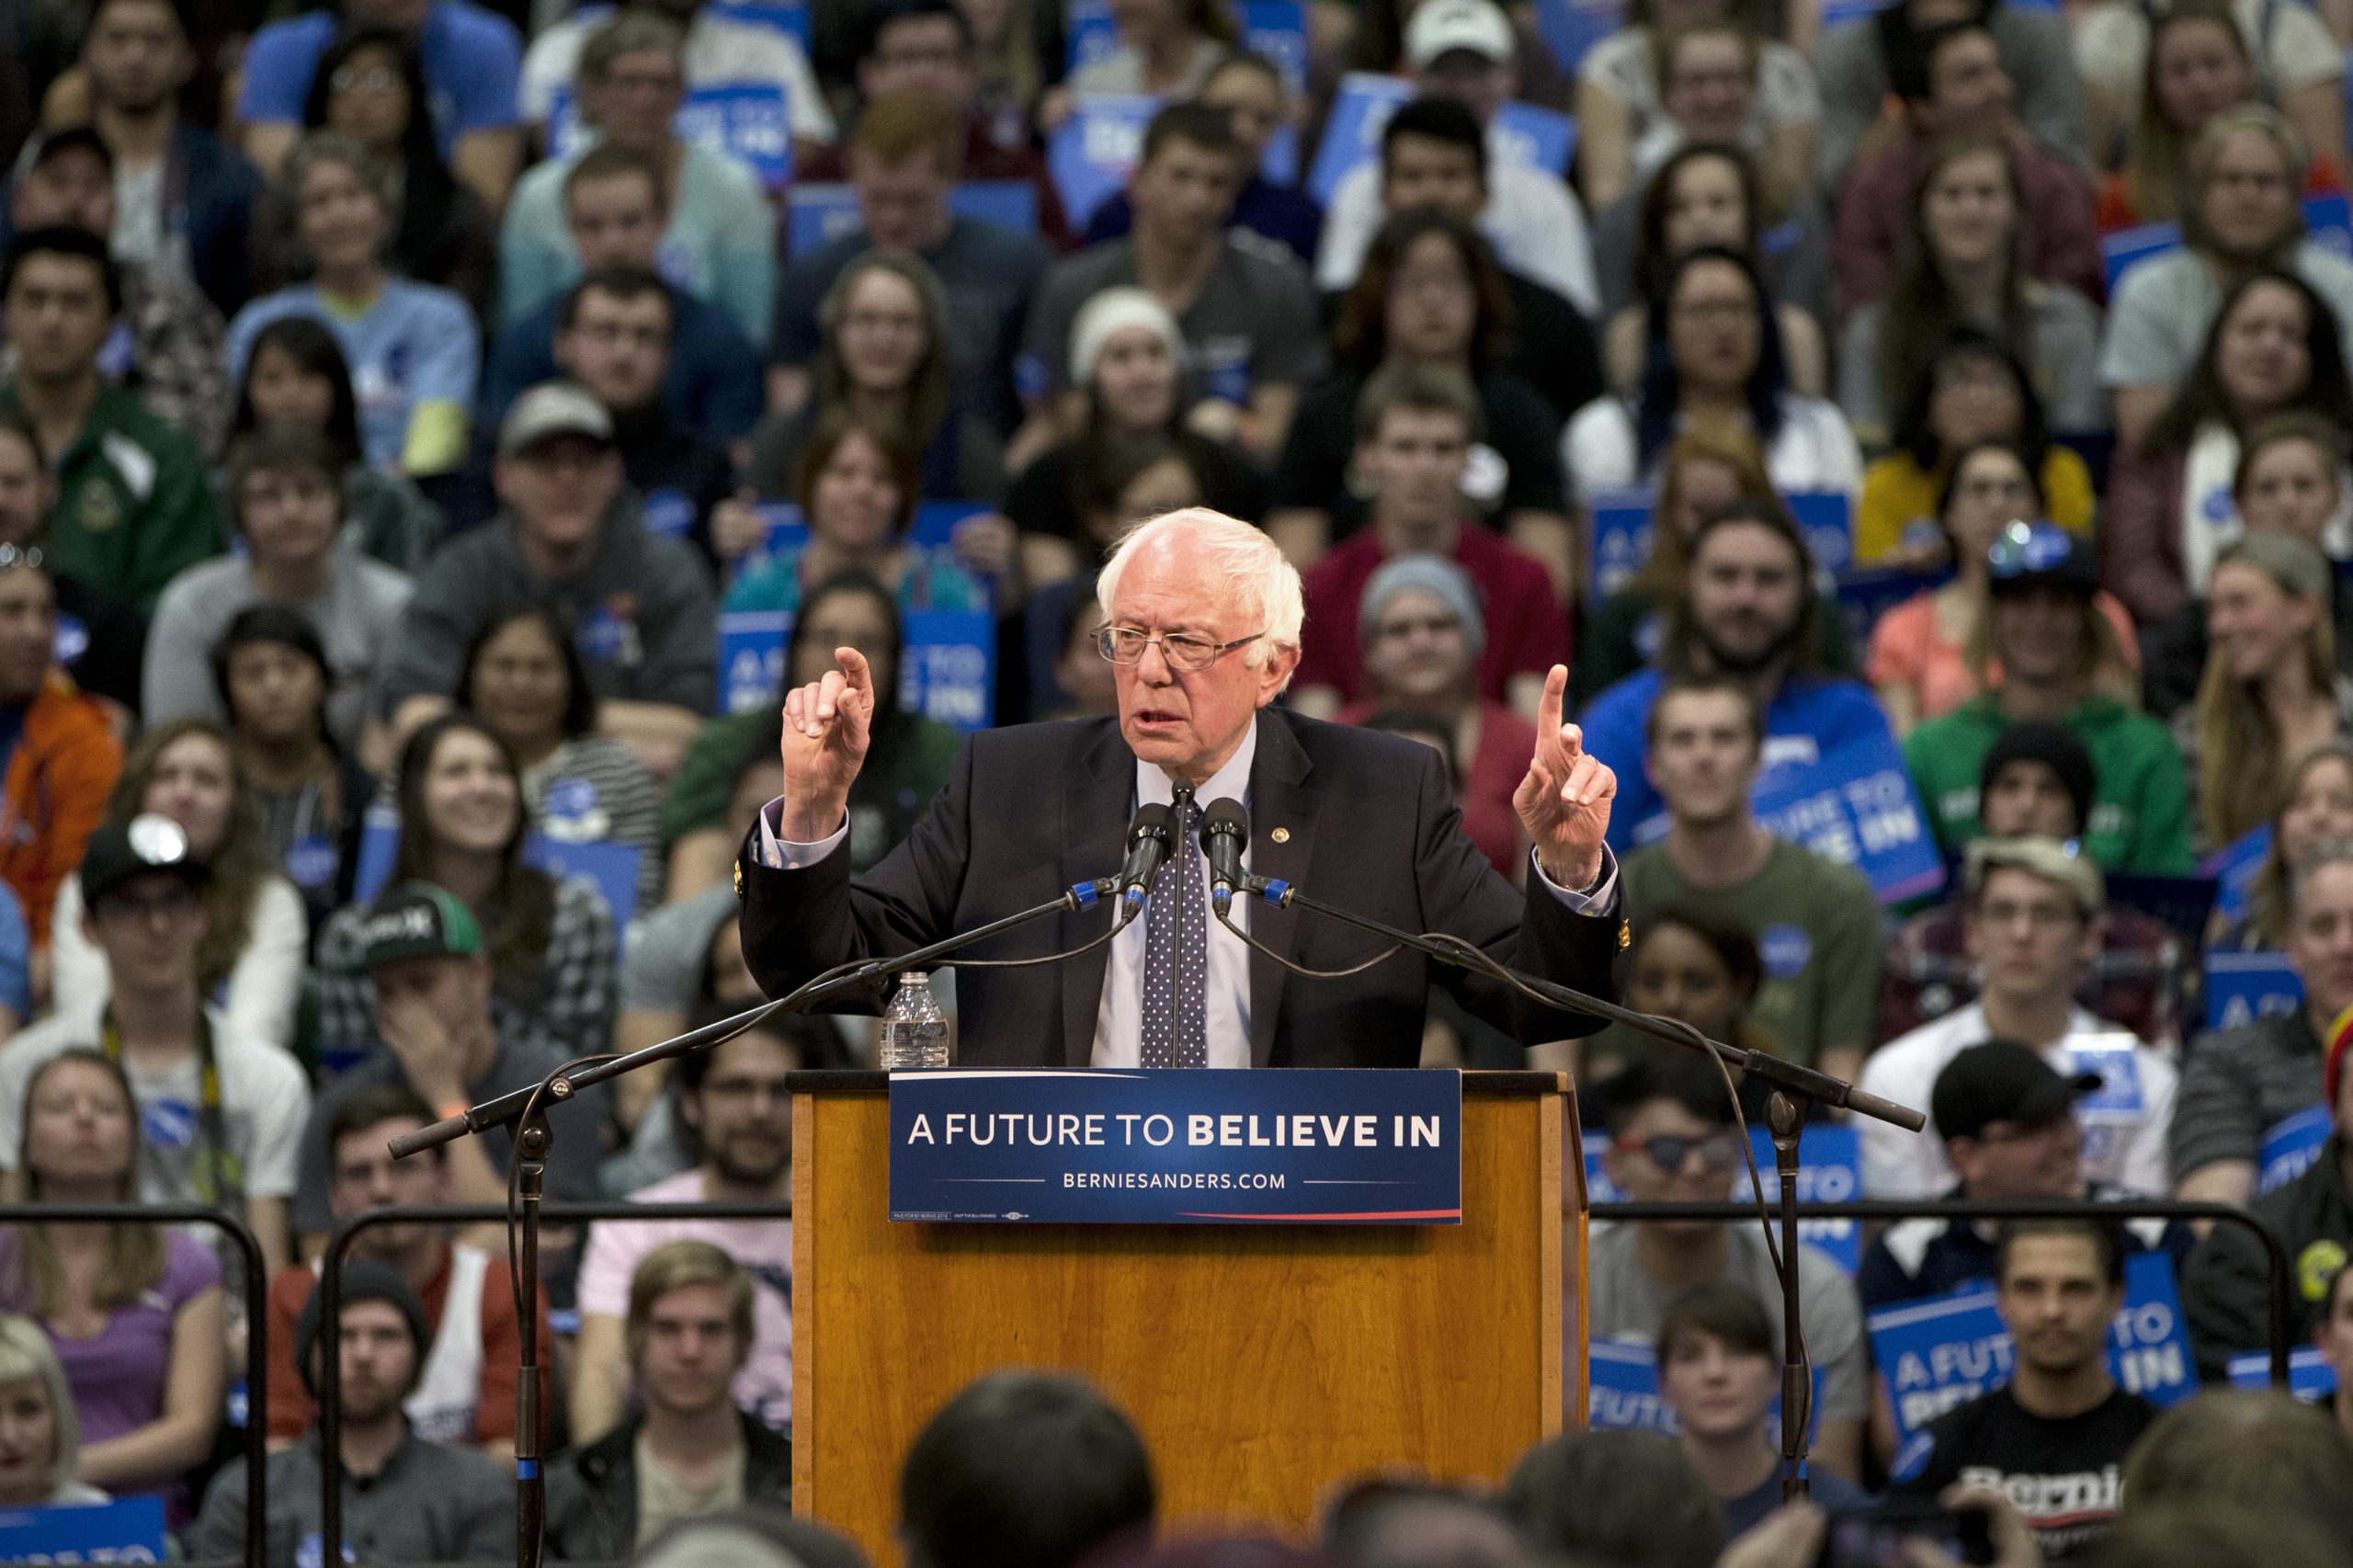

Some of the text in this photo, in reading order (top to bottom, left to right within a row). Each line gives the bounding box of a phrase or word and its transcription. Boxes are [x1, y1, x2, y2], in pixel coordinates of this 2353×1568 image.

[908, 1114, 1440, 1148] A FUTURE TO BELIEVE IN
[1063, 1173, 1285, 1189] BERNIESANDERS.COM
[1895, 1350, 1930, 1393] A
[2120, 1341, 2186, 1395] IN
[1960, 1464, 2125, 1515] Berni
